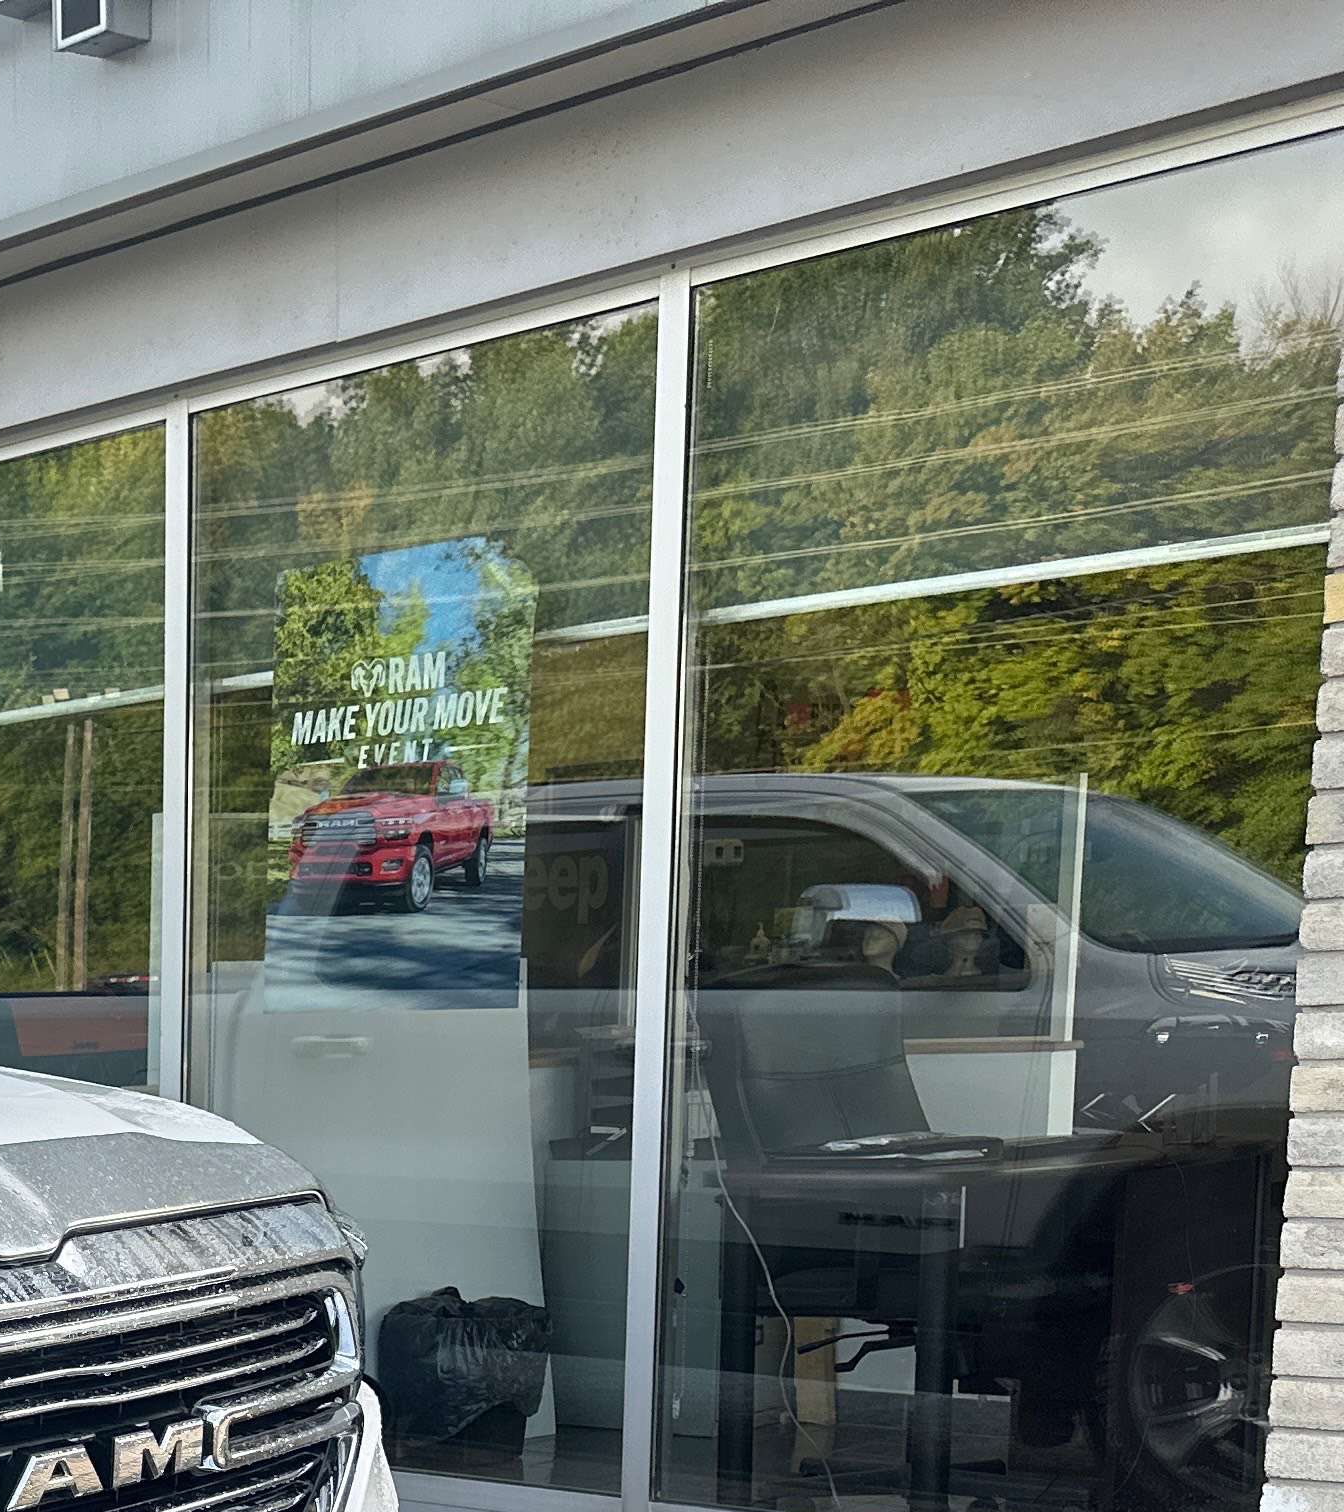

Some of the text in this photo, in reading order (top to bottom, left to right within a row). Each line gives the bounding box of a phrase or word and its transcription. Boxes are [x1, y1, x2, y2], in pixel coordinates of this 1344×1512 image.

[388, 651, 447, 694] RAM
[291, 686, 510, 747] MAKE YOUR MOVE
[357, 737, 434, 769] EVENT
[525, 854, 610, 926] eep
